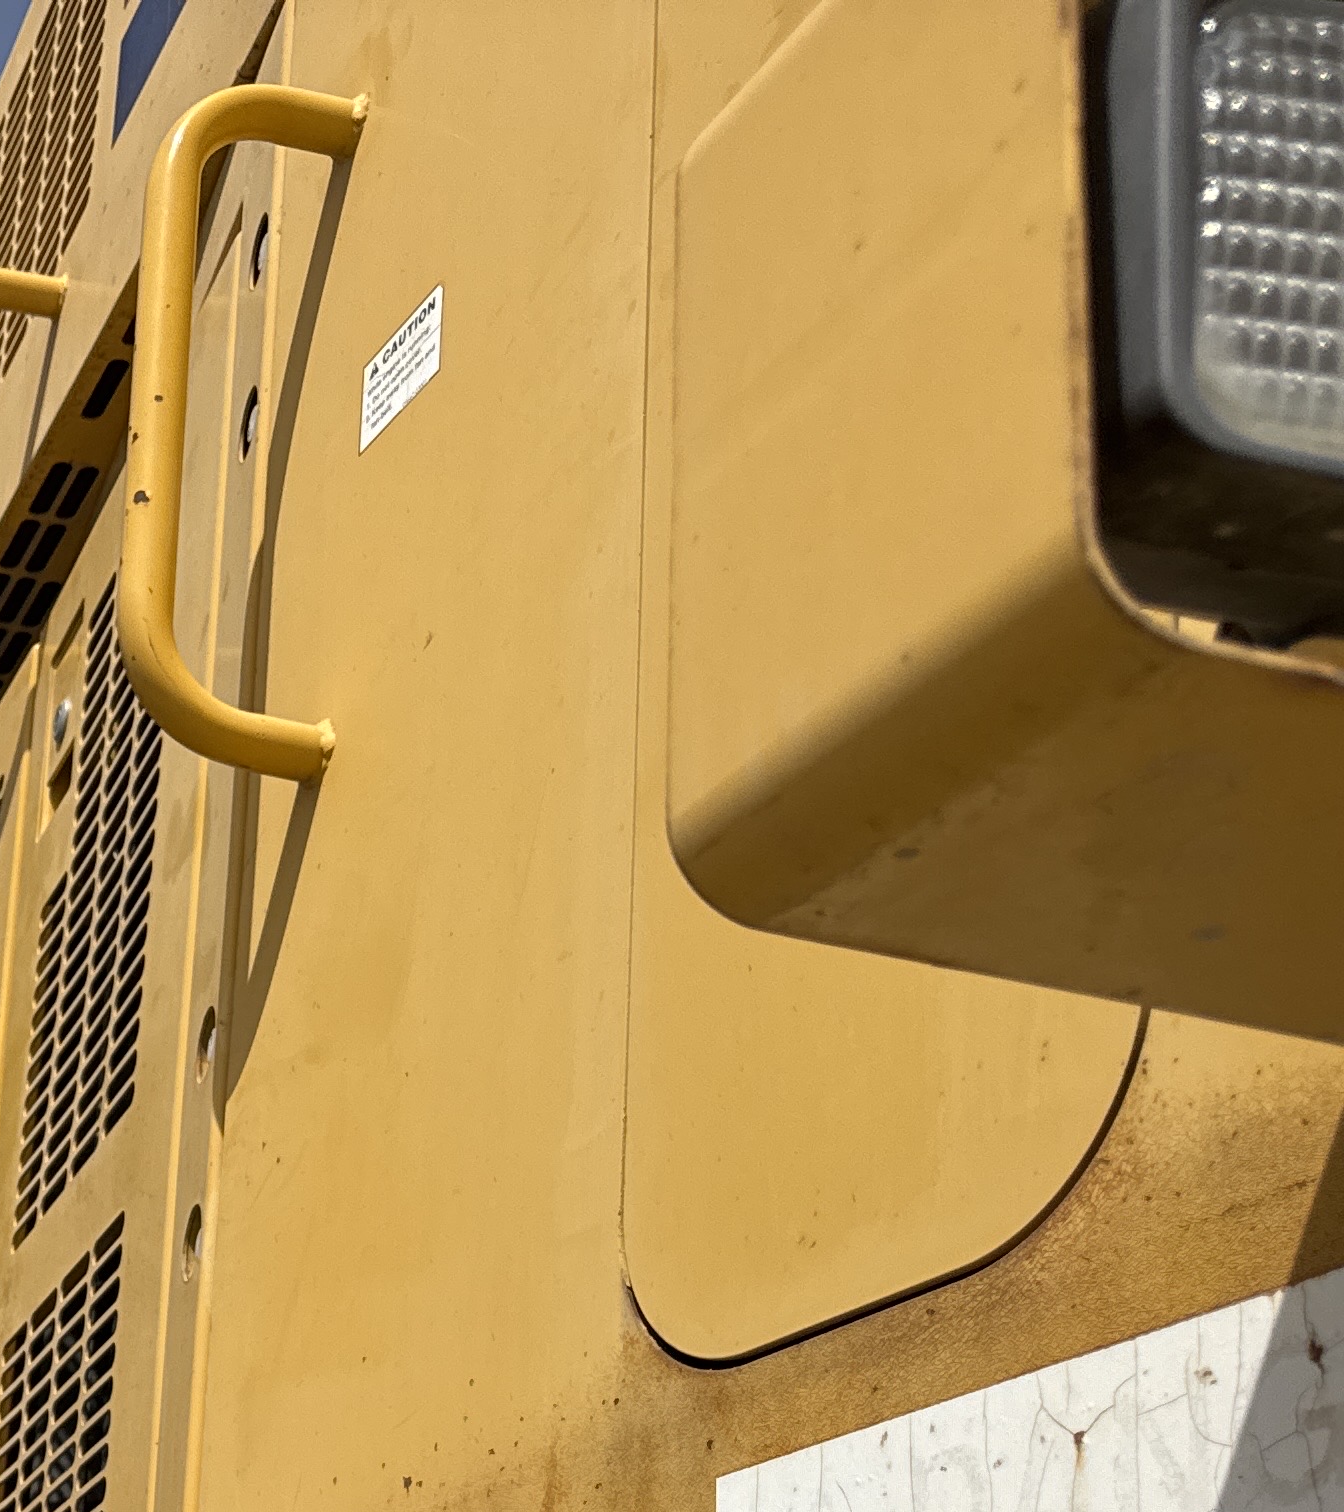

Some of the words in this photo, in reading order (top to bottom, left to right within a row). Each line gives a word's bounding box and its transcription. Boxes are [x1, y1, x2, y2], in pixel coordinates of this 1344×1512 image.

[382, 296, 436, 365] CAUTION
[372, 400, 385, 416] Keep
[386, 383, 400, 401] away
[401, 369, 414, 385] from
[415, 357, 424, 370] fan
[425, 343, 436, 360] and
[372, 393, 380, 404] Do
[381, 381, 390, 395] not
[390, 366, 405, 384] open
